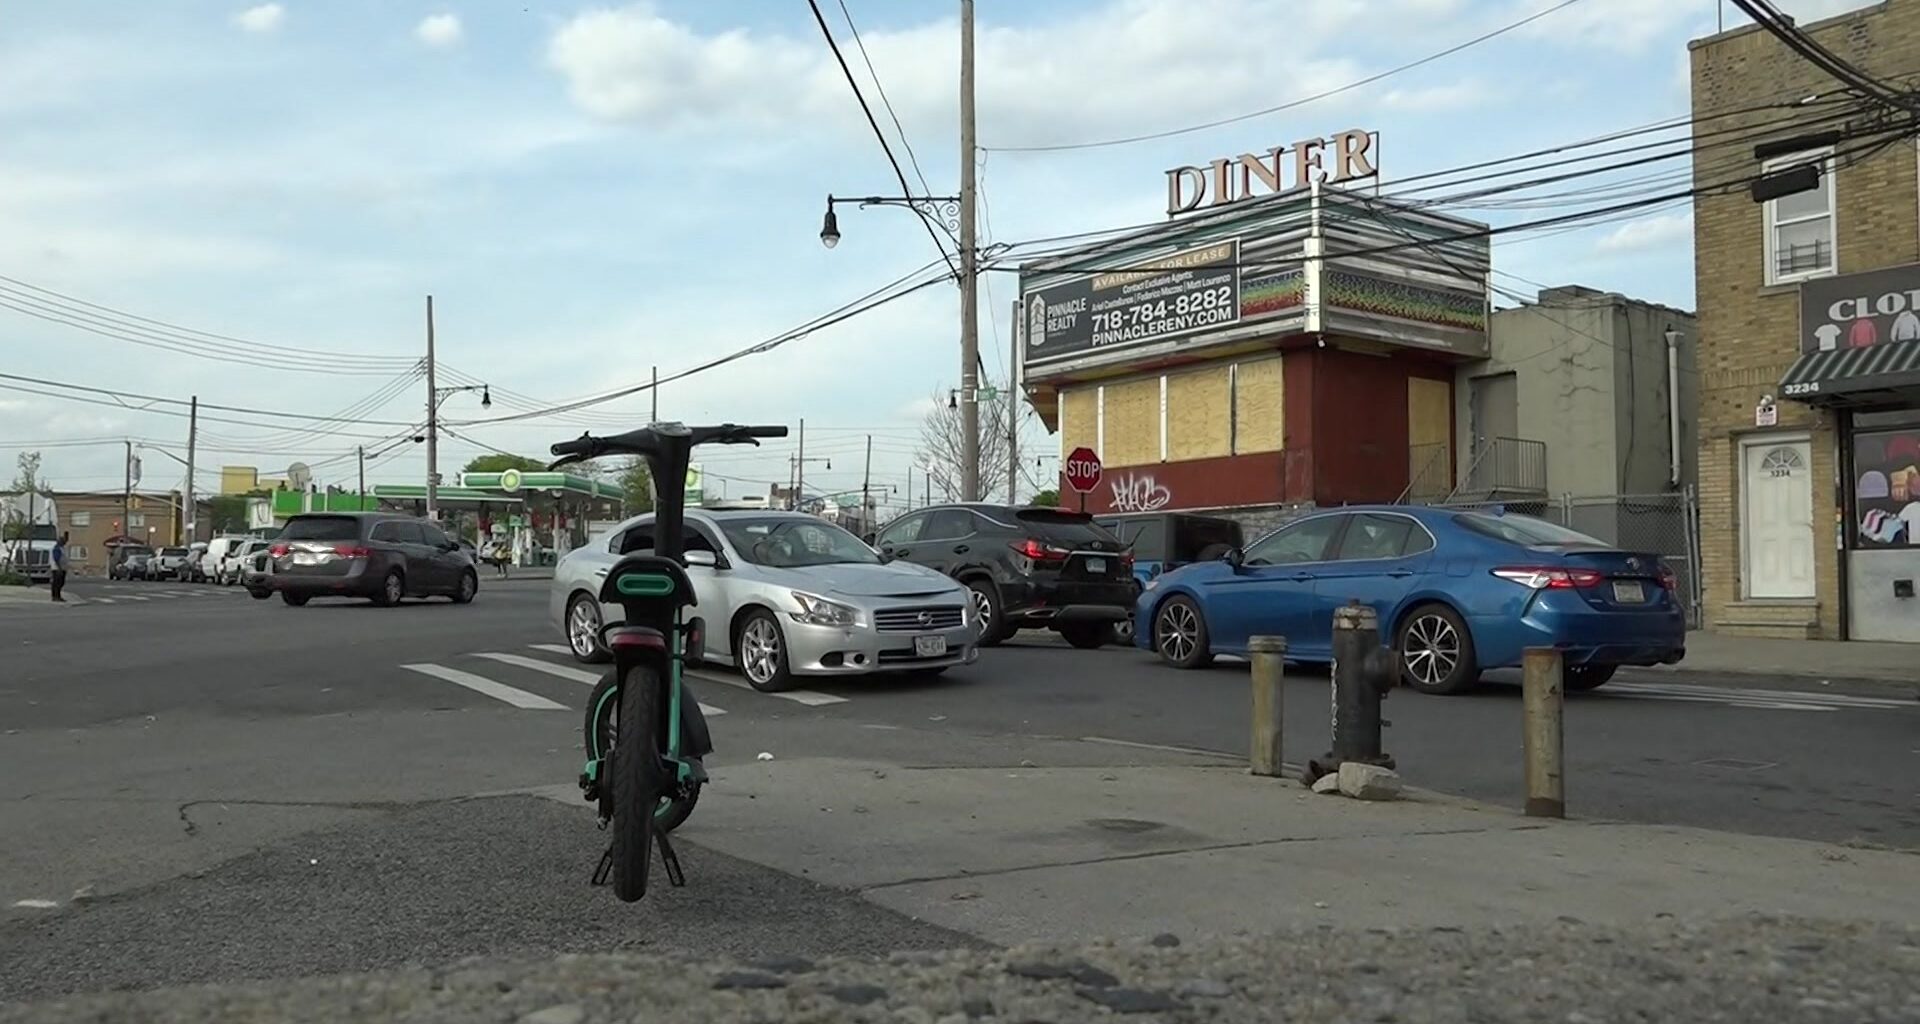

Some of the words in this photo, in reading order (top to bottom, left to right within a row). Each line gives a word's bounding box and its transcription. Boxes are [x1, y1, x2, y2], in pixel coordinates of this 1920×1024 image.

[1165, 129, 1377, 216] DINER
[1094, 265, 1155, 289] AVAILABE
[1186, 247, 1226, 266] LEASE
[1122, 281, 1144, 294] Contact
[1048, 296, 1087, 319] PINNACLE
[1091, 286, 1232, 332] 718-784-8282
[1048, 313, 1078, 333] REALTY
[1091, 306, 1233, 346] PINNACLERENY.COM
[1785, 382, 1820, 394] 3234
[1067, 460, 1099, 479] STOP
[1770, 469, 1791, 478] 3234
